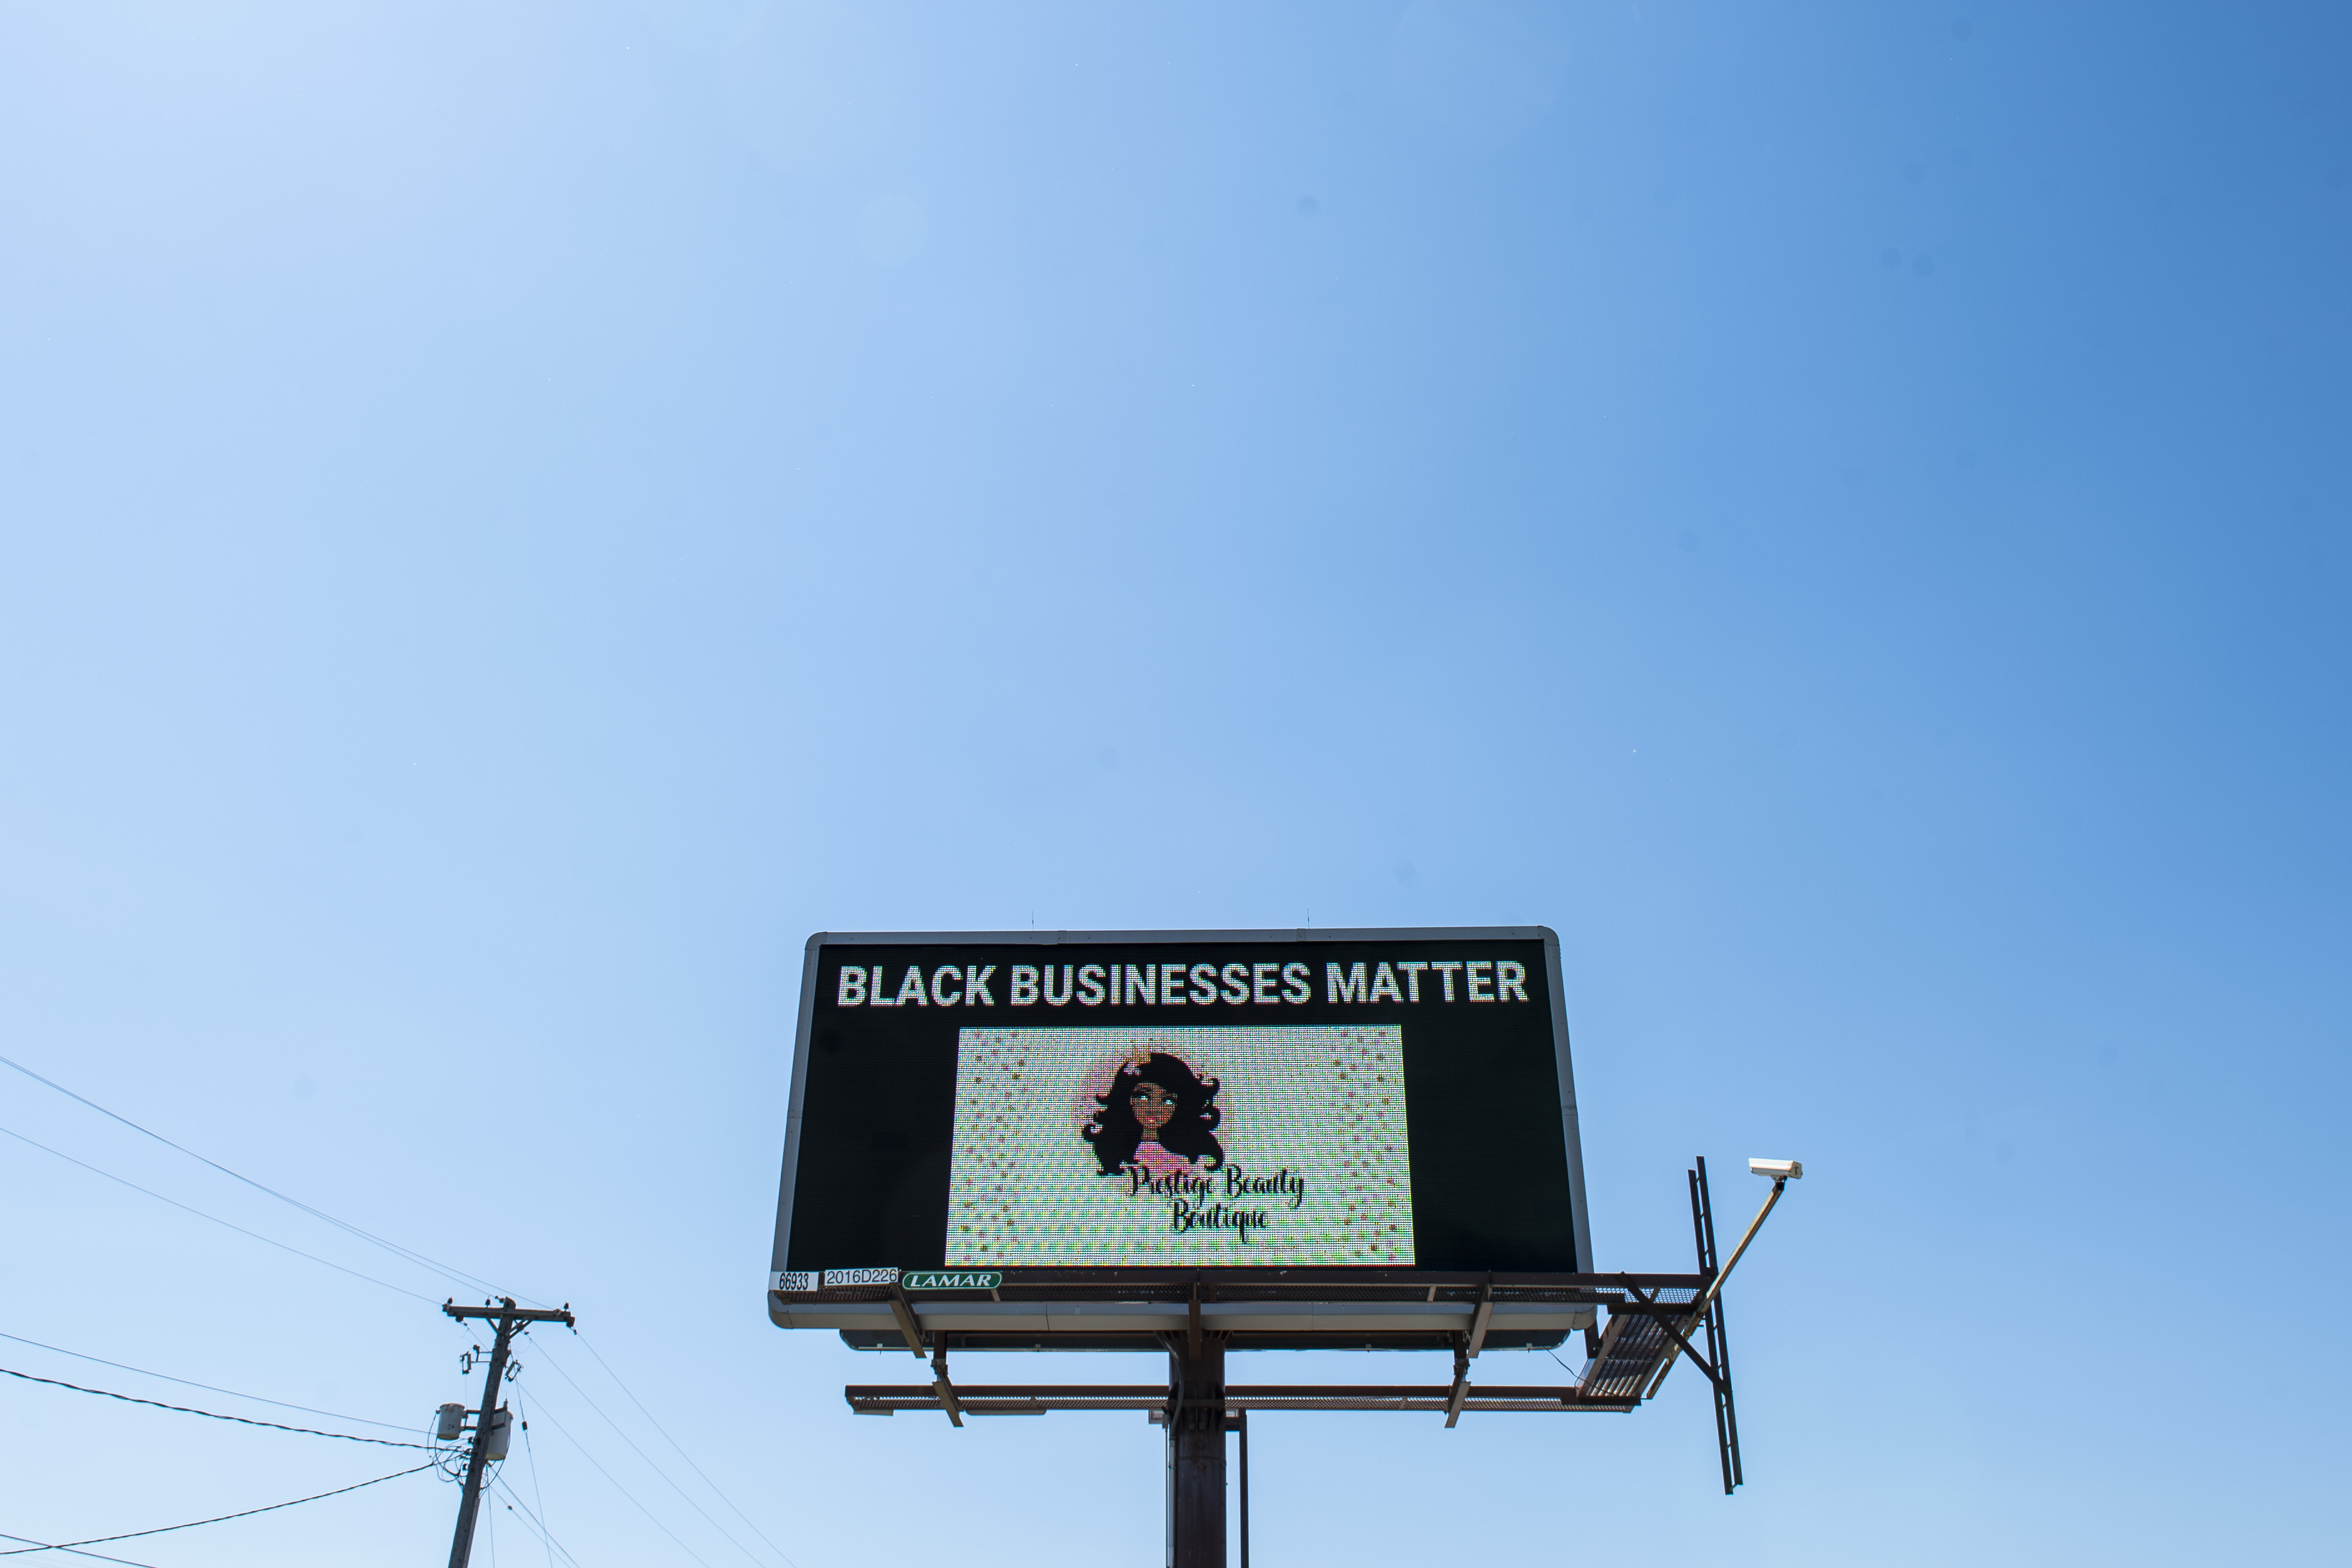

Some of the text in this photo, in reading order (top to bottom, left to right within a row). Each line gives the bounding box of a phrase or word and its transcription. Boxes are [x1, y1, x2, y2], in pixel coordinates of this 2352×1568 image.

[837, 961, 1529, 1007] BLACK BUSINESSES MATTER
[1125, 1163, 1304, 1209] Prestige Beauty
[1169, 1197, 1269, 1243] Boutique
[827, 1269, 897, 1284] 2016D226
[910, 1274, 992, 1287] LAMAR
